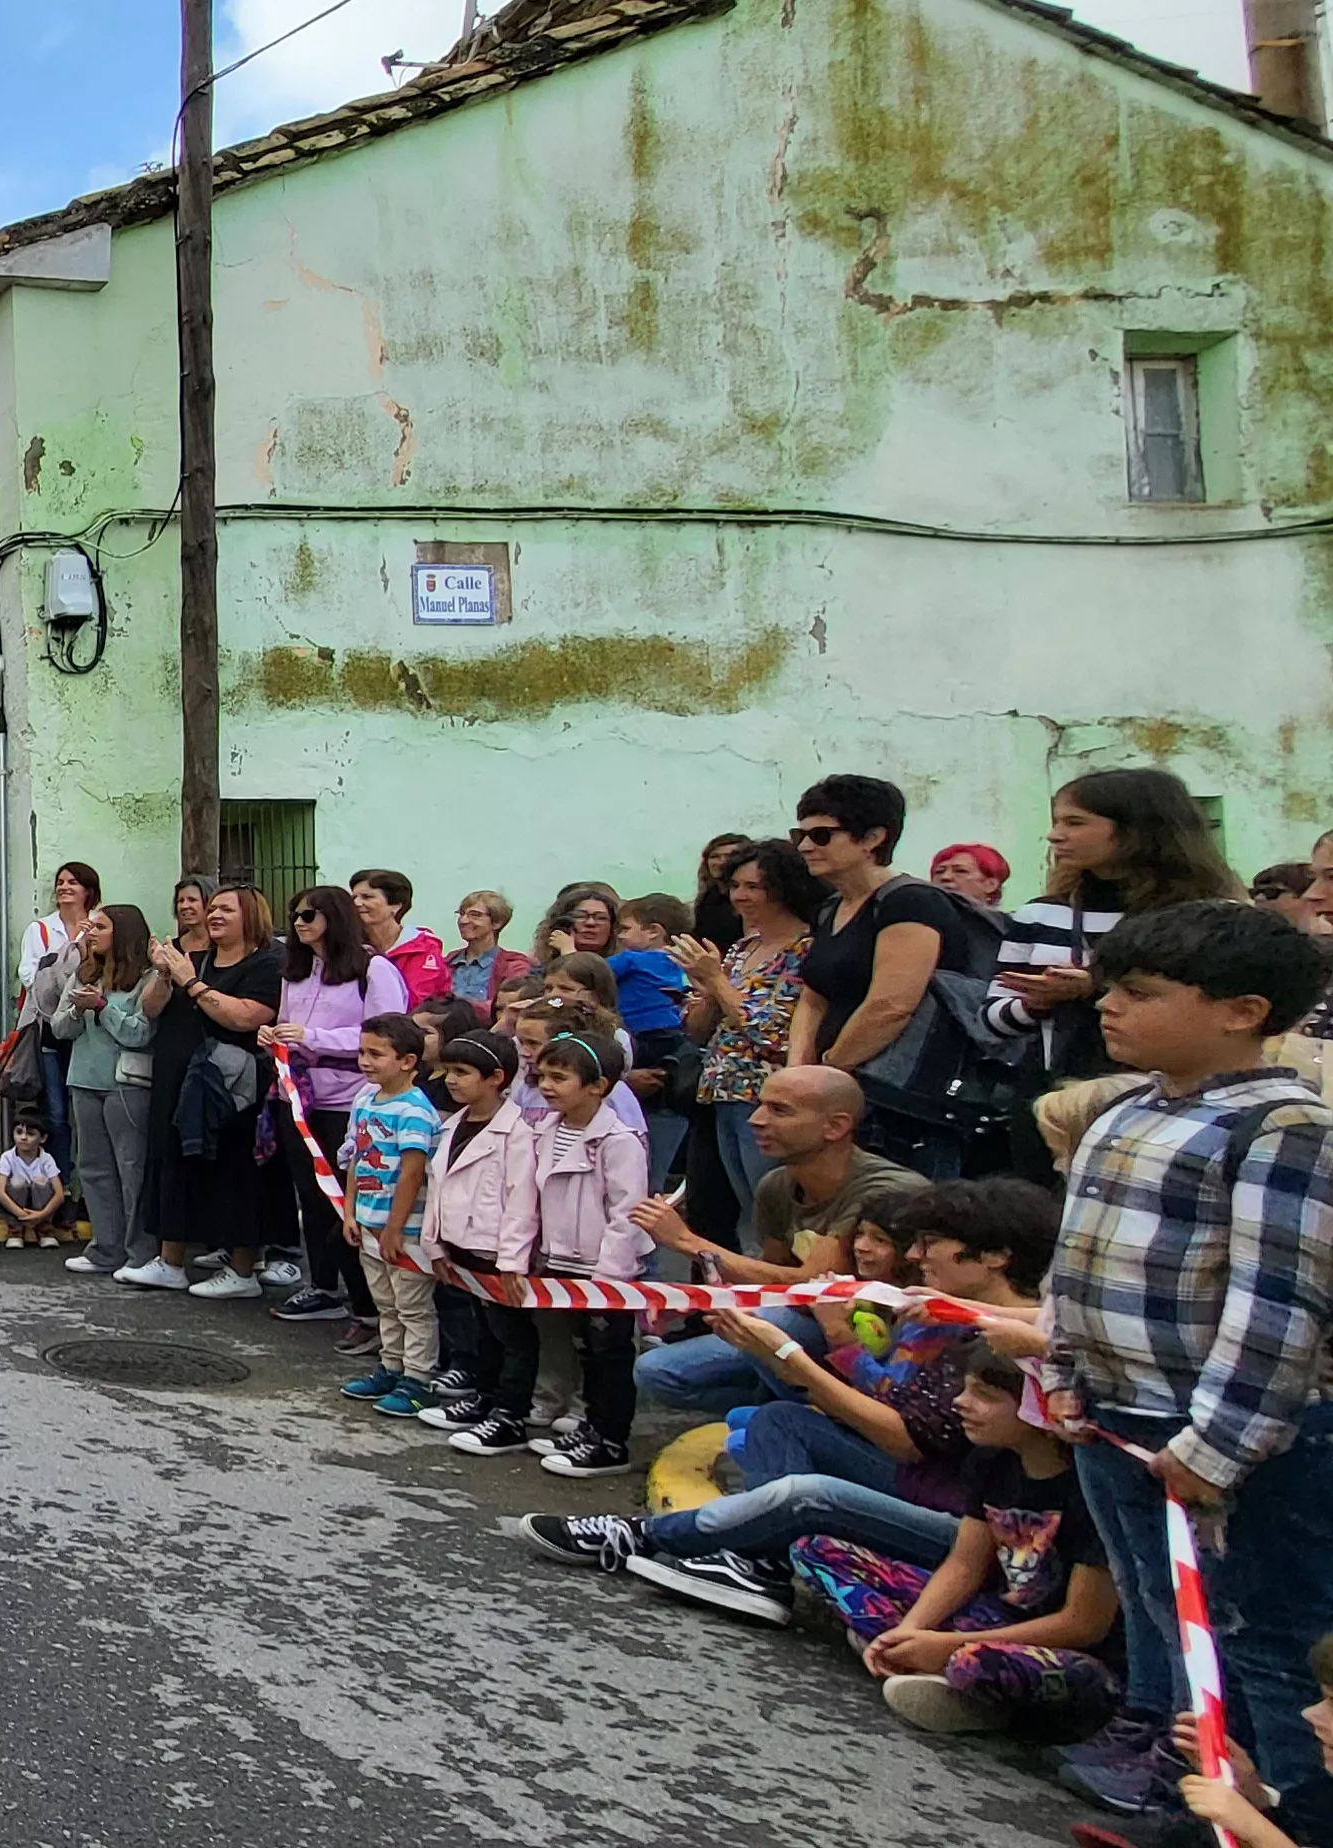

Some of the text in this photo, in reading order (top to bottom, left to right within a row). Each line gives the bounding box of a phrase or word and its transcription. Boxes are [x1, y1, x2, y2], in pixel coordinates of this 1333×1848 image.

[444, 575, 482, 590] Calle
[420, 596, 490, 613] Manuel Planas
